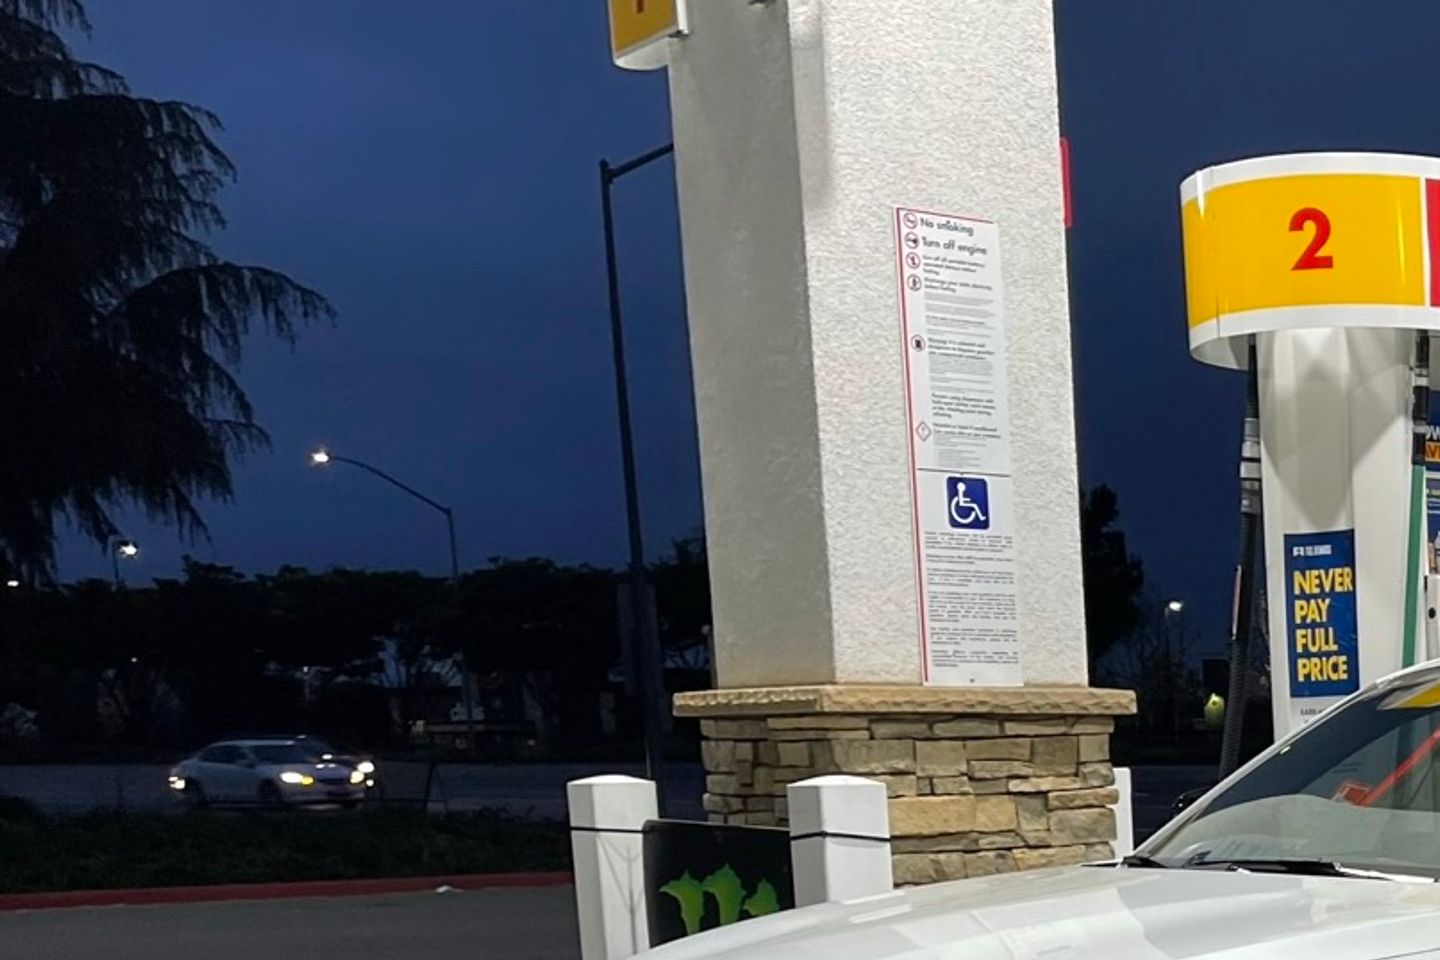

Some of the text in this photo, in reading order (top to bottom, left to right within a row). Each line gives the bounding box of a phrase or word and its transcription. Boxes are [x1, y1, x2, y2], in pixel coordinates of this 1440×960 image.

[920, 217, 975, 237] No smoking
[1289, 207, 1333, 271] 2
[922, 236, 987, 256] Turn off engine
[1293, 566, 1353, 595] NEVER
[1294, 598, 1330, 624] PAY
[1295, 627, 1338, 653] FULL
[1297, 655, 1348, 682] PRICE
